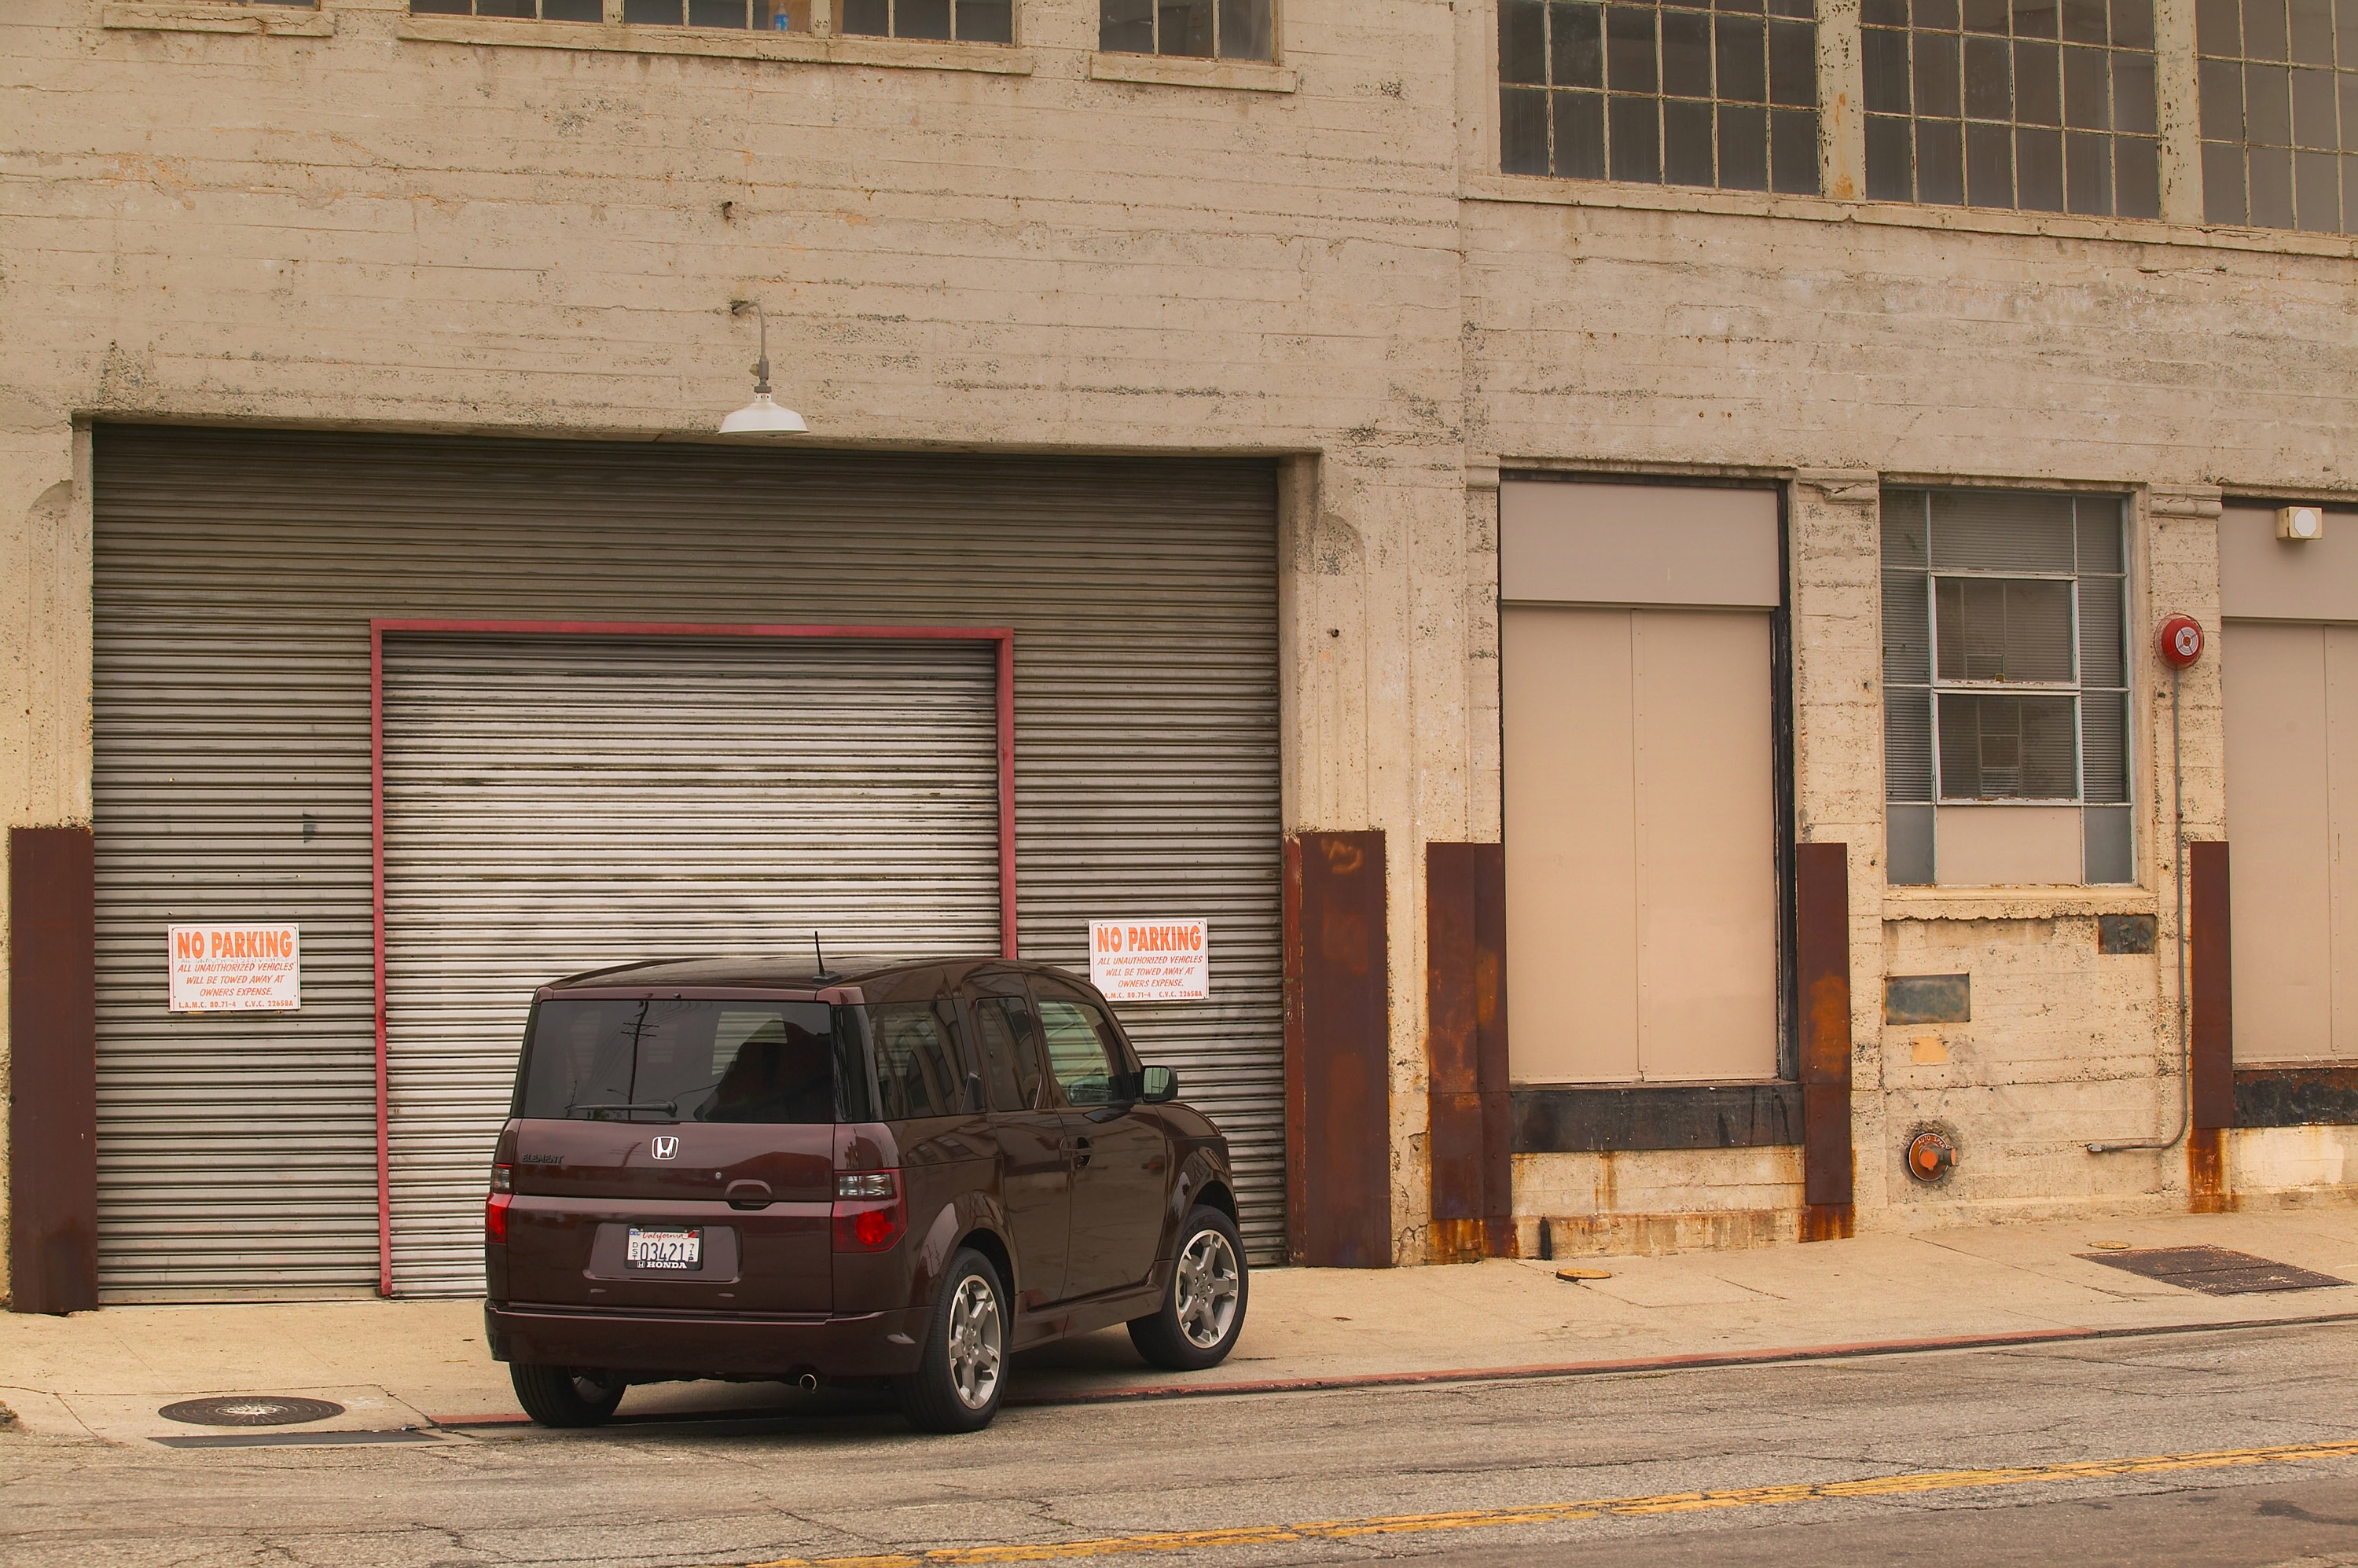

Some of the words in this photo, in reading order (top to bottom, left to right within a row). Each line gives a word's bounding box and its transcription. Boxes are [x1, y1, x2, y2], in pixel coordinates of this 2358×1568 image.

[1097, 927, 1122, 953] NO
[1128, 925, 1202, 952] PARKING
[177, 931, 204, 959] NO
[211, 931, 293, 958] PARKING
[1097, 957, 1111, 965] ALL
[1113, 956, 1168, 965] UNAUTHORIZED
[1170, 955, 1203, 964] VEHICLES
[177, 963, 192, 973] ALL
[194, 963, 255, 972] UNAUTHORIZED
[258, 962, 294, 971] VEHICLES
[1124, 968, 1134, 976] BE
[1162, 967, 1185, 975] AWAY
[185, 975, 204, 985] WILL
[207, 975, 218, 984] BE
[220, 975, 248, 984] TOWED
[249, 975, 274, 983] AWAY
[274, 975, 285, 983] AT
[1118, 979, 1150, 988] OWNERS
[1151, 979, 1184, 987] EXPENSE.
[200, 988, 235, 997] OWNERS
[236, 987, 273, 996] EXPENSE.
[522, 1153, 564, 1164] ELEMENT
